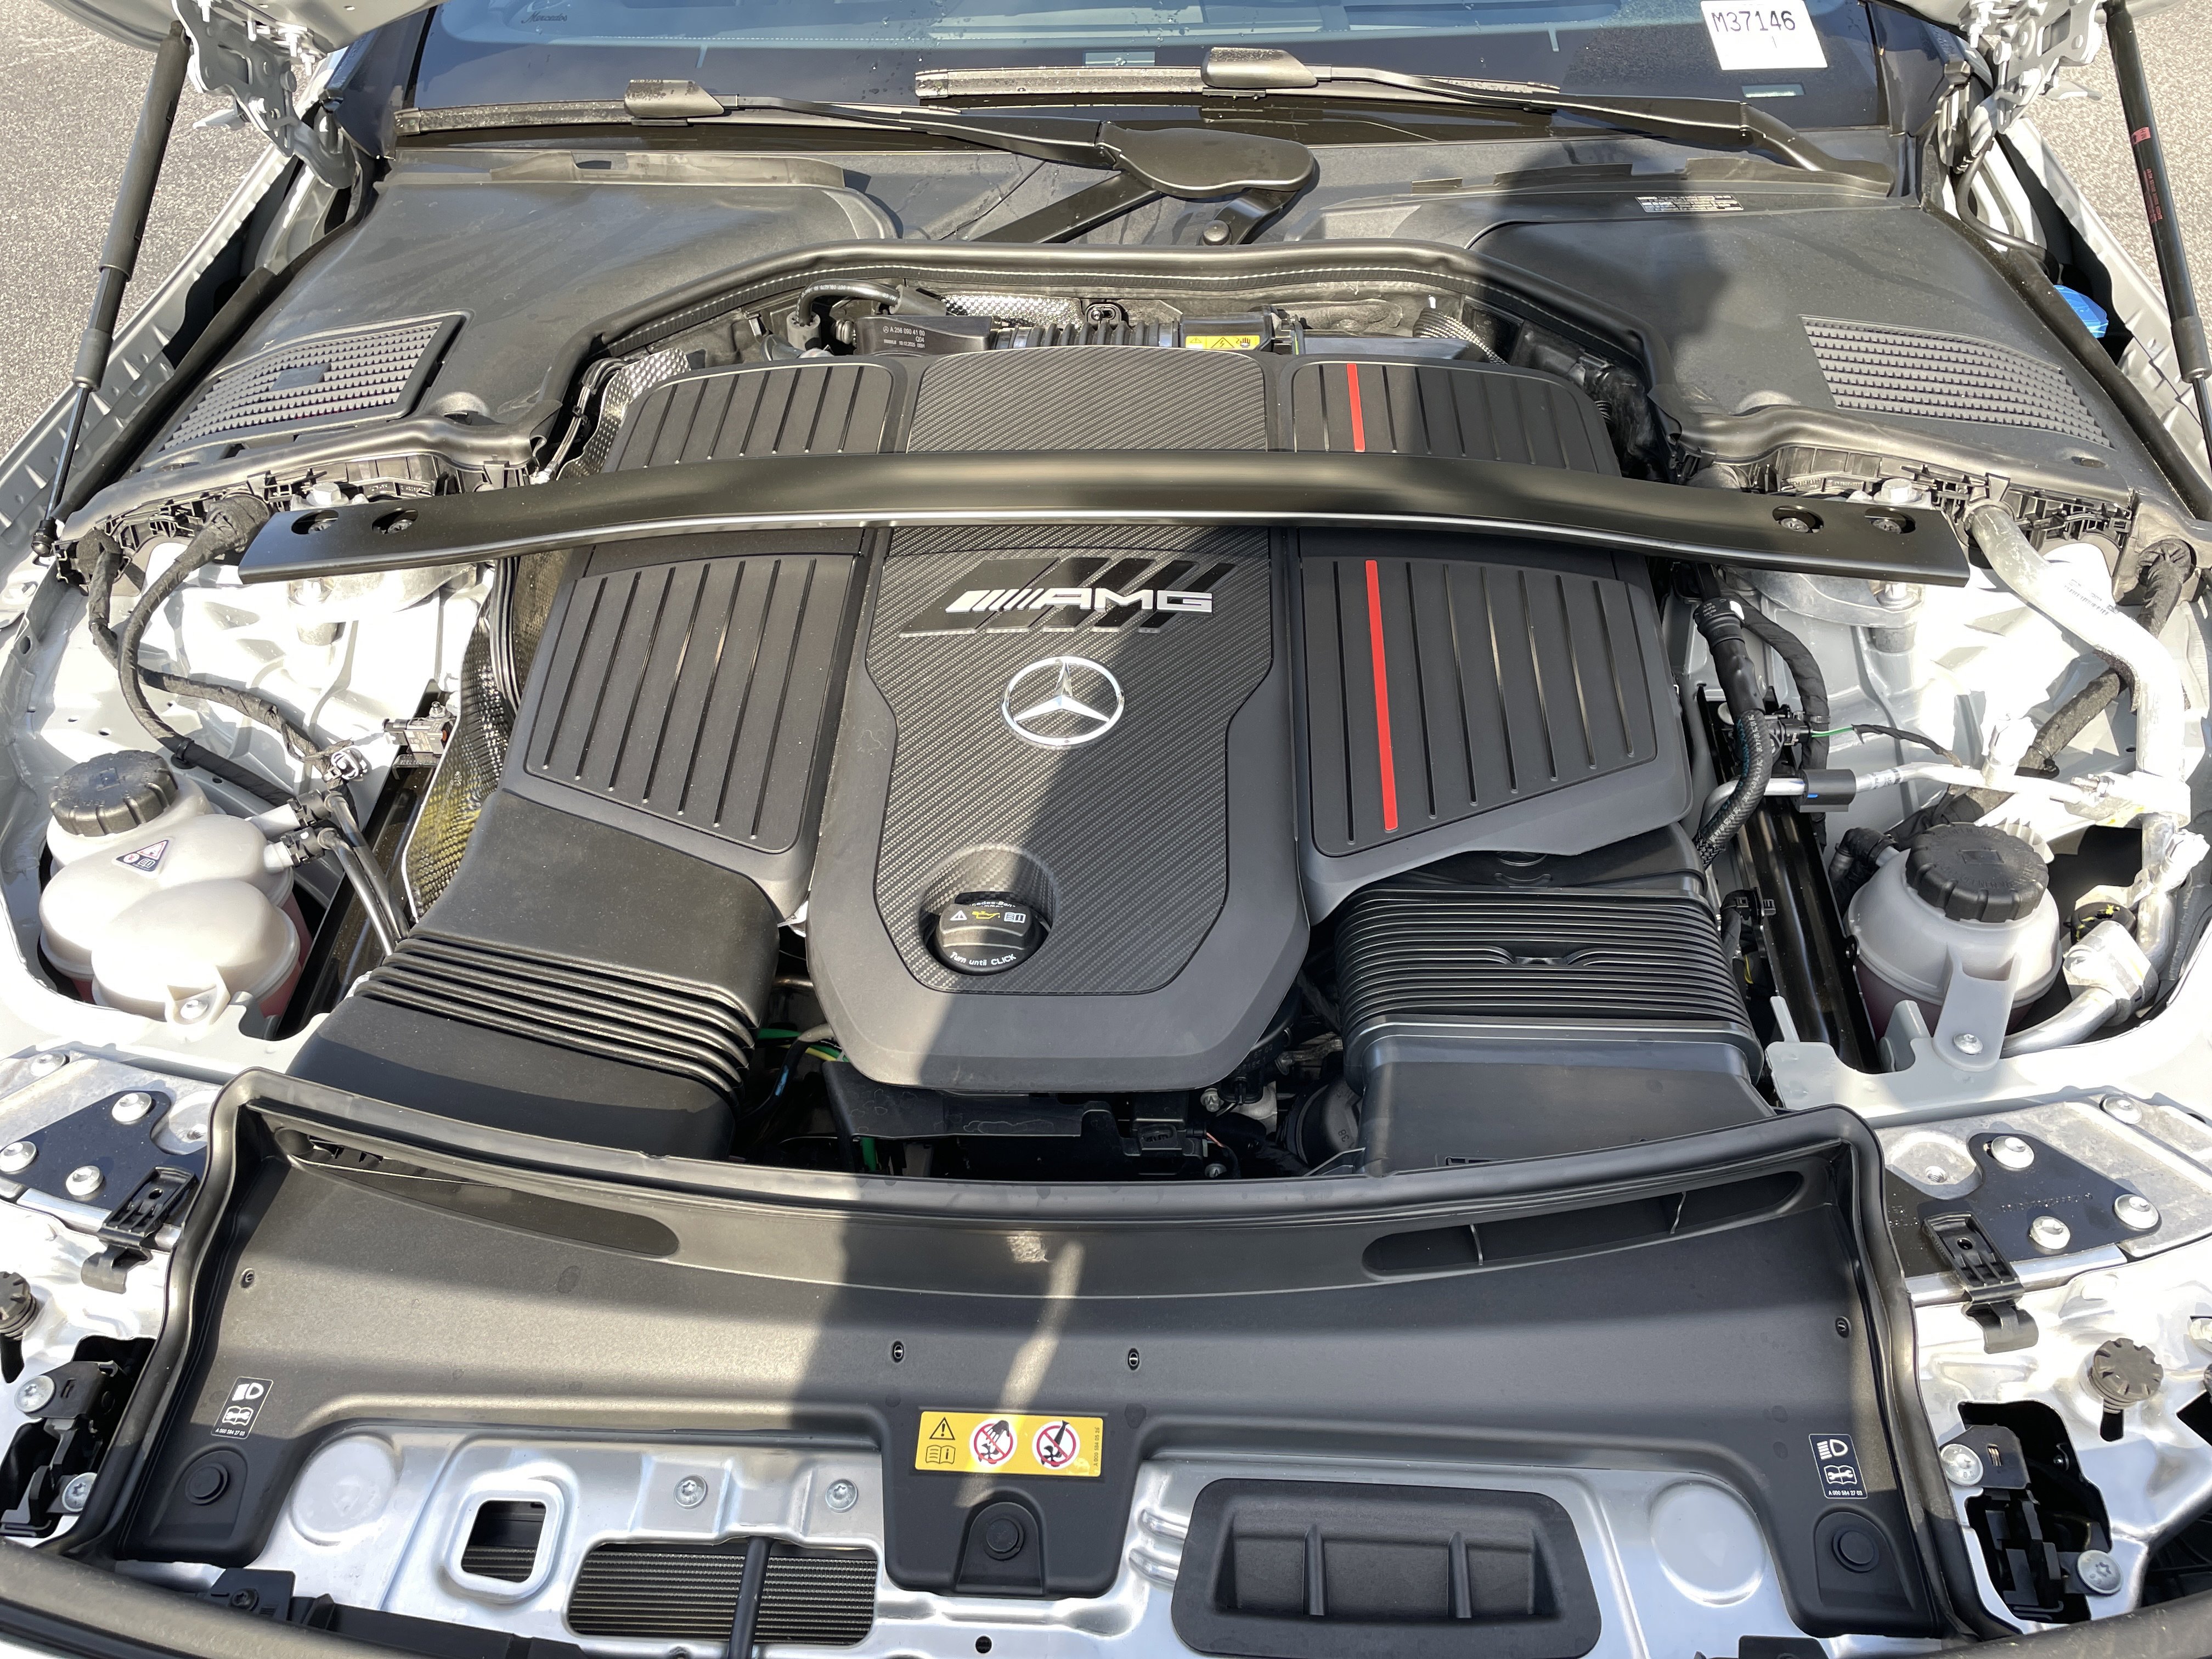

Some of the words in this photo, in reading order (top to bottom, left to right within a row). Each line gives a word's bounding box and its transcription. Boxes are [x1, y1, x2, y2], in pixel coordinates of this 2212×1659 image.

[1711, 10, 1795, 32] M37146
[1029, 587, 1213, 613] AMG
[950, 951, 967, 963] Turn
[990, 953, 1017, 966] CLICK
